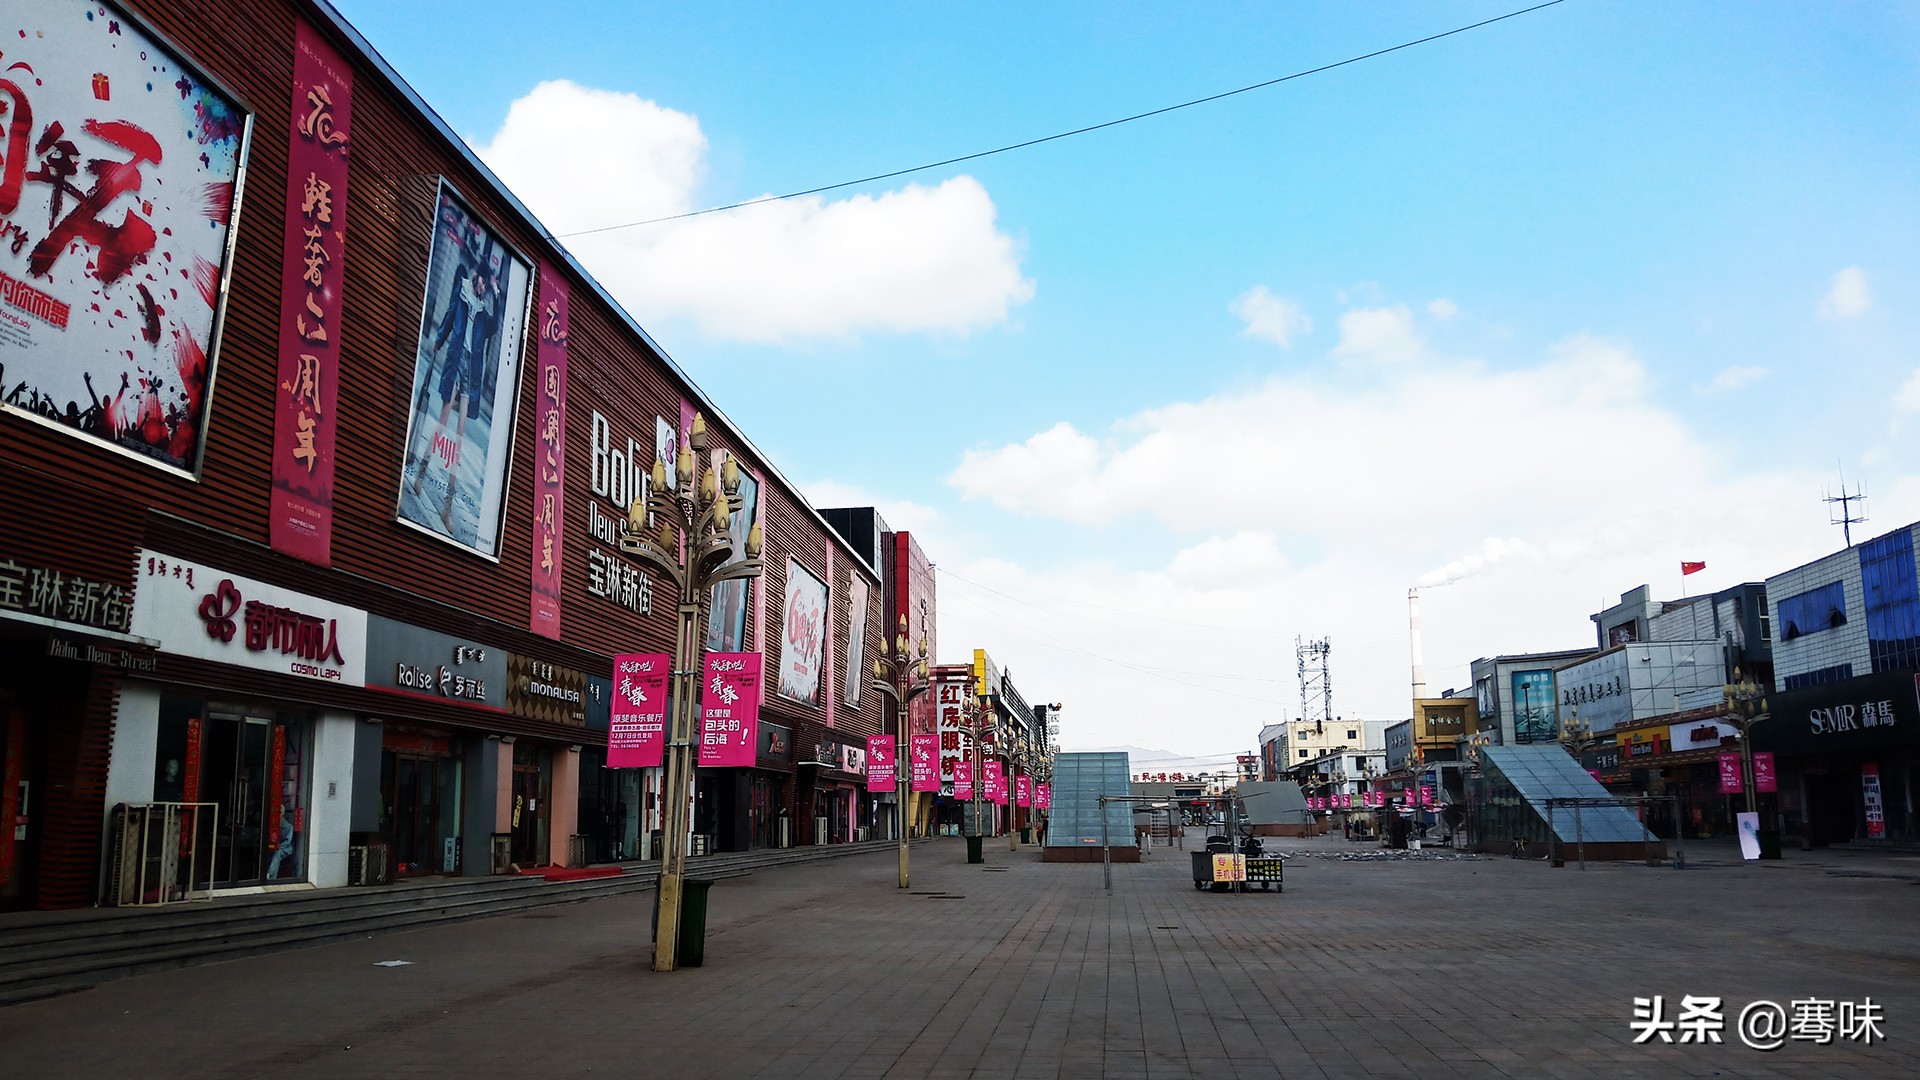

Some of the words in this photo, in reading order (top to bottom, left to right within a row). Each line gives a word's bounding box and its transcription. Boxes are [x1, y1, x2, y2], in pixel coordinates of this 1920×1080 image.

[588, 548, 653, 616] 宝琳新街
[245, 600, 345, 665] 都市丽人
[397, 663, 432, 690] Rolise
[454, 675, 486, 700] 罗丽丝
[710, 673, 739, 705] 青春
[531, 681, 580, 703] MONALISA
[619, 675, 647, 707] 青春
[705, 719, 740, 731] 包头的
[704, 733, 727, 745] 后海
